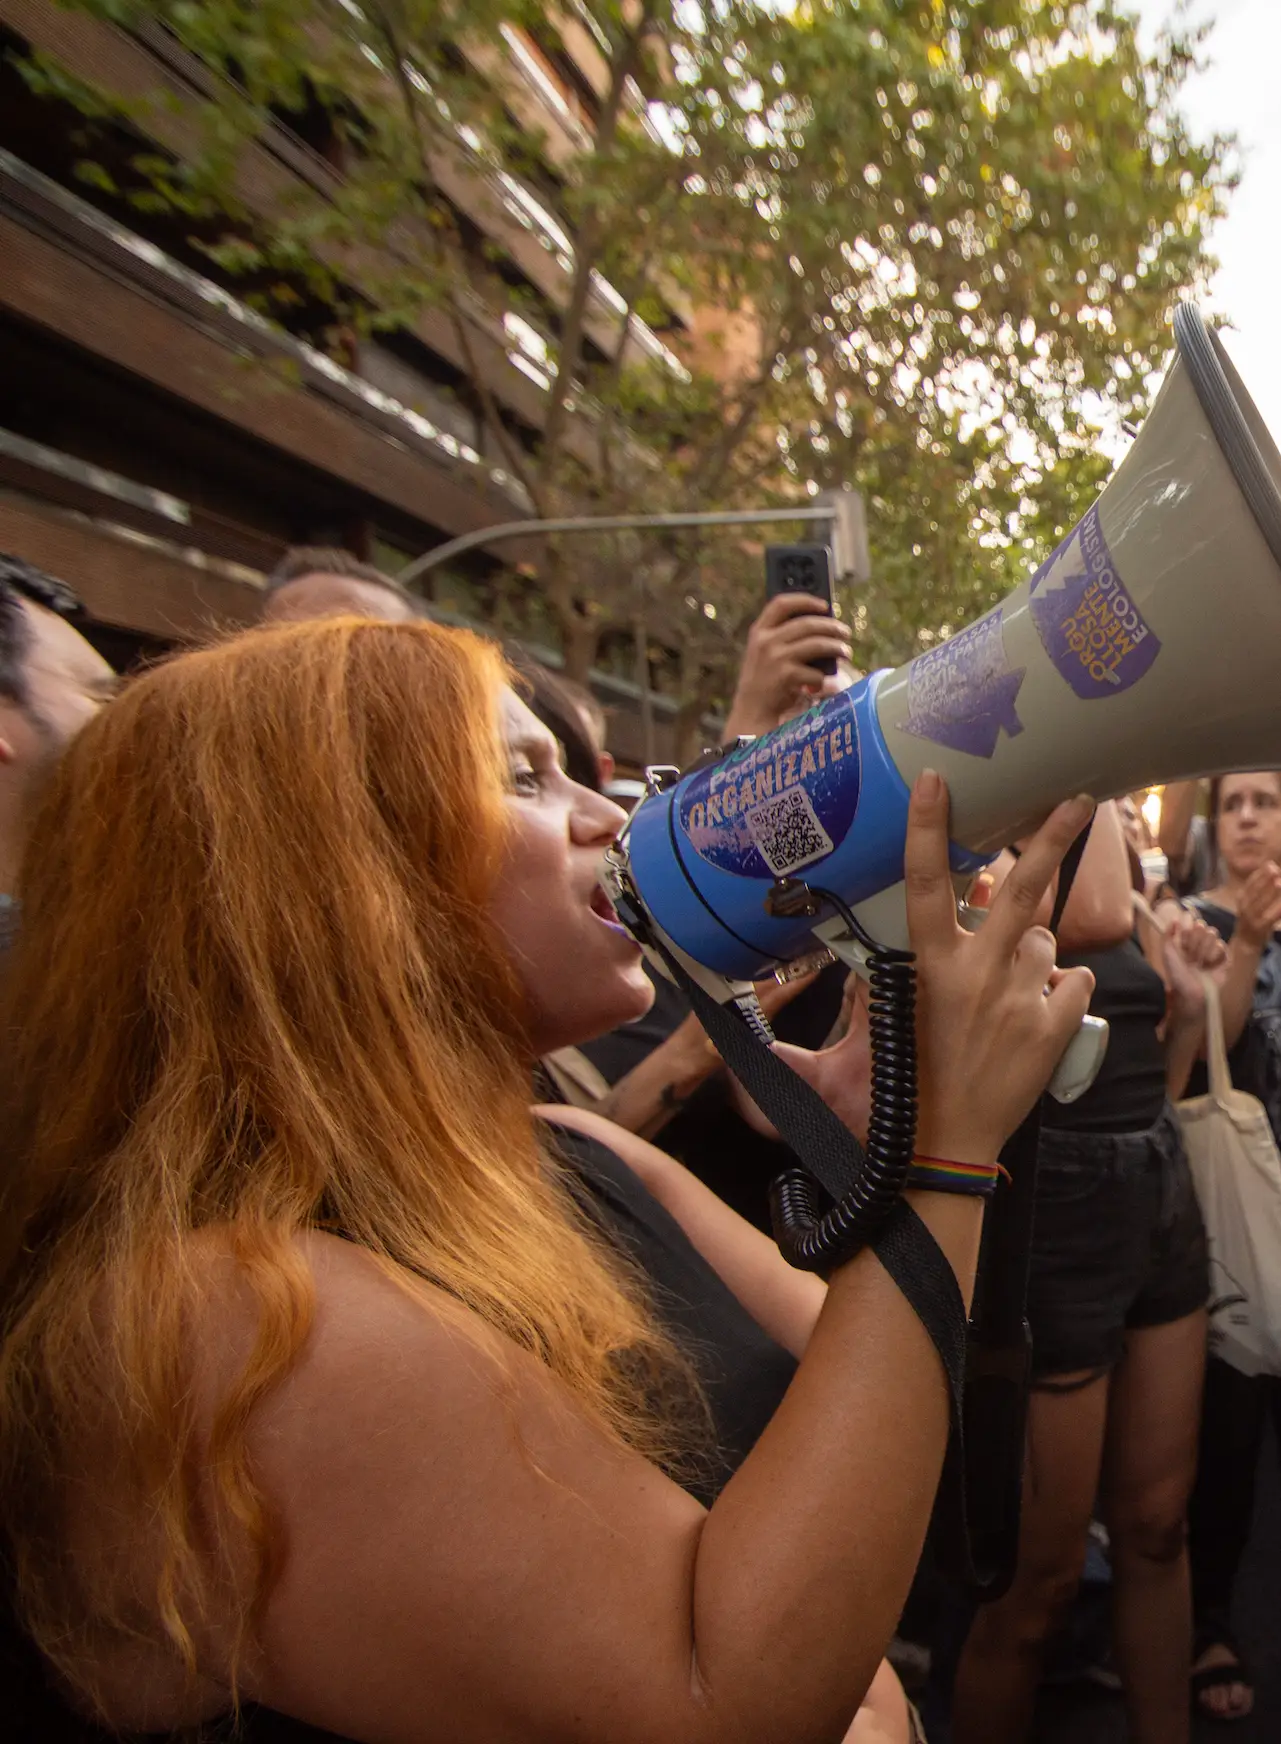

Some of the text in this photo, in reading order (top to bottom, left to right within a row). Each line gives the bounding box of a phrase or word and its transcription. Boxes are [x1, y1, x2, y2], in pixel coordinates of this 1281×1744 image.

[1083, 511, 1148, 644] ECOLOGISTAS
[915, 616, 997, 669] LAS CASAS
[1060, 617, 1106, 681] ORGU
[1074, 600, 1122, 669] LLOSA
[1084, 582, 1136, 656] MENTE
[913, 655, 950, 679] SON
[688, 722, 853, 834] ORGANÍZATE!
[710, 715, 824, 794] Podemos
